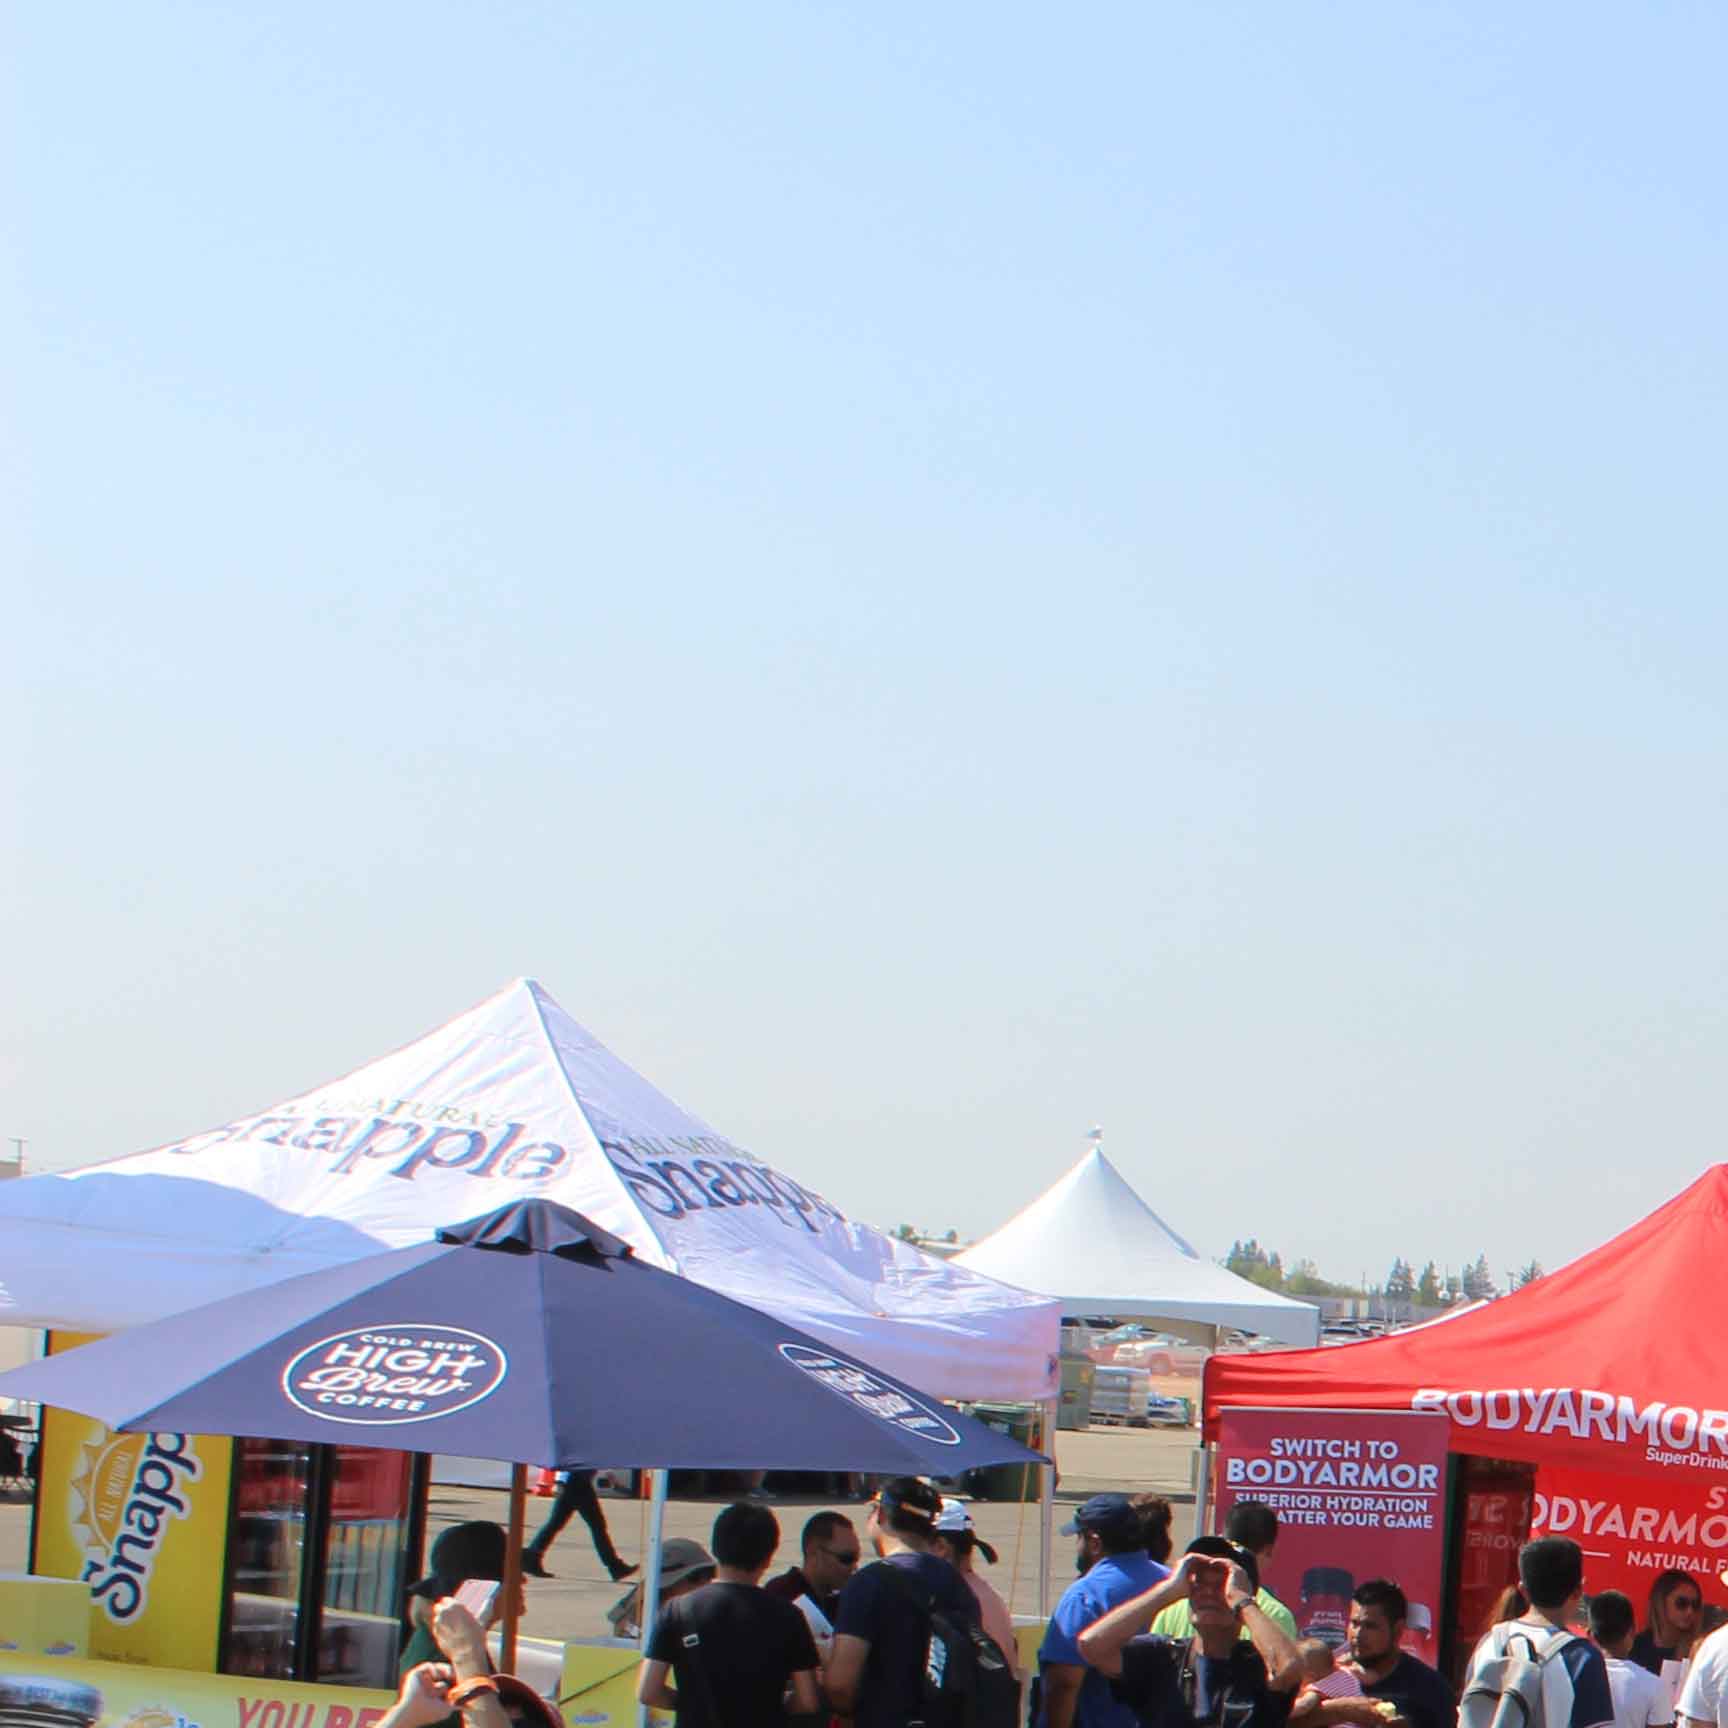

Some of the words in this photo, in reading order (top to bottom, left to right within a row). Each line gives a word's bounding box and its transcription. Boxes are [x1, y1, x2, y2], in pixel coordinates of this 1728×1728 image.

[359, 1333, 414, 1348] COLD
[420, 1339, 478, 1353] BREW
[324, 1343, 487, 1377] HIGH
[299, 1367, 473, 1398] Brew
[316, 1391, 427, 1412] COFFEE
[1270, 1438, 1362, 1458] SWITCH
[1367, 1441, 1399, 1459] TO
[1226, 1458, 1439, 1489] BODYARMOR
[1326, 1496, 1428, 1513] HYDRATION
[81, 1433, 197, 1618] Snapp
[1276, 1511, 1327, 1525] ATTER
[1332, 1512, 1379, 1527] YOUR
[1384, 1514, 1433, 1529] GAME
[1626, 1551, 1711, 1575] NATURAL
